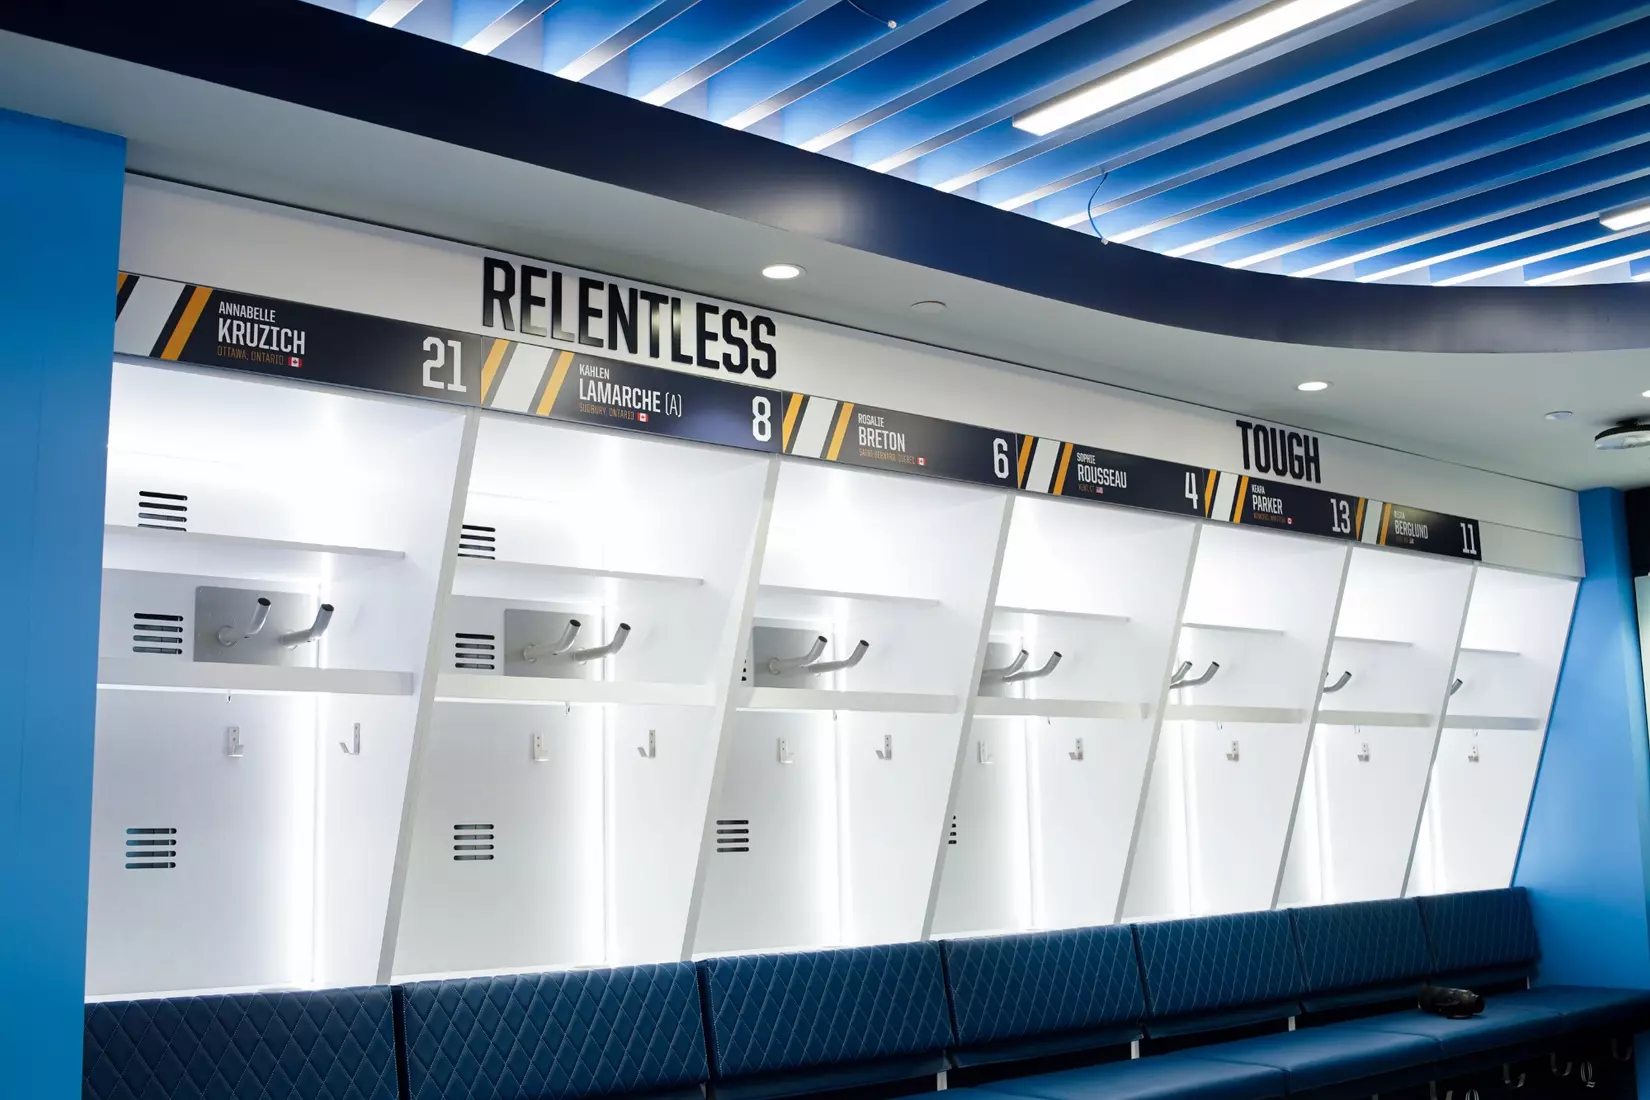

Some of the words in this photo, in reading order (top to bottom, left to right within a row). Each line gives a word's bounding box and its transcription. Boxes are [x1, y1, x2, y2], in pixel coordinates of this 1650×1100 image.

[218, 301, 277, 323] ANNABELLE
[482, 256, 777, 380] RELENTLESS
[218, 317, 306, 355] KRUZICH
[217, 345, 249, 361] OTTAWA,
[251, 350, 284, 366] ONTARIO
[422, 336, 467, 393] 21
[579, 363, 610, 380] KAHLEN
[579, 378, 661, 413] LAMARCHE
[665, 392, 682, 418] (A)
[752, 395, 772, 442] 8
[858, 412, 884, 428] ROSALIE
[858, 426, 906, 453] BRETON
[1236, 419, 1322, 484] TOUGH
[992, 437, 1010, 479] 6
[1076, 452, 1096, 465] SOPHIE
[1077, 463, 1128, 489] ROUSSEAU
[1185, 471, 1199, 509] 4
[1252, 494, 1284, 515] PARKER
[1330, 498, 1351, 534] 13
[1394, 519, 1429, 540] BERGLUND
[1460, 522, 1478, 555] 11
